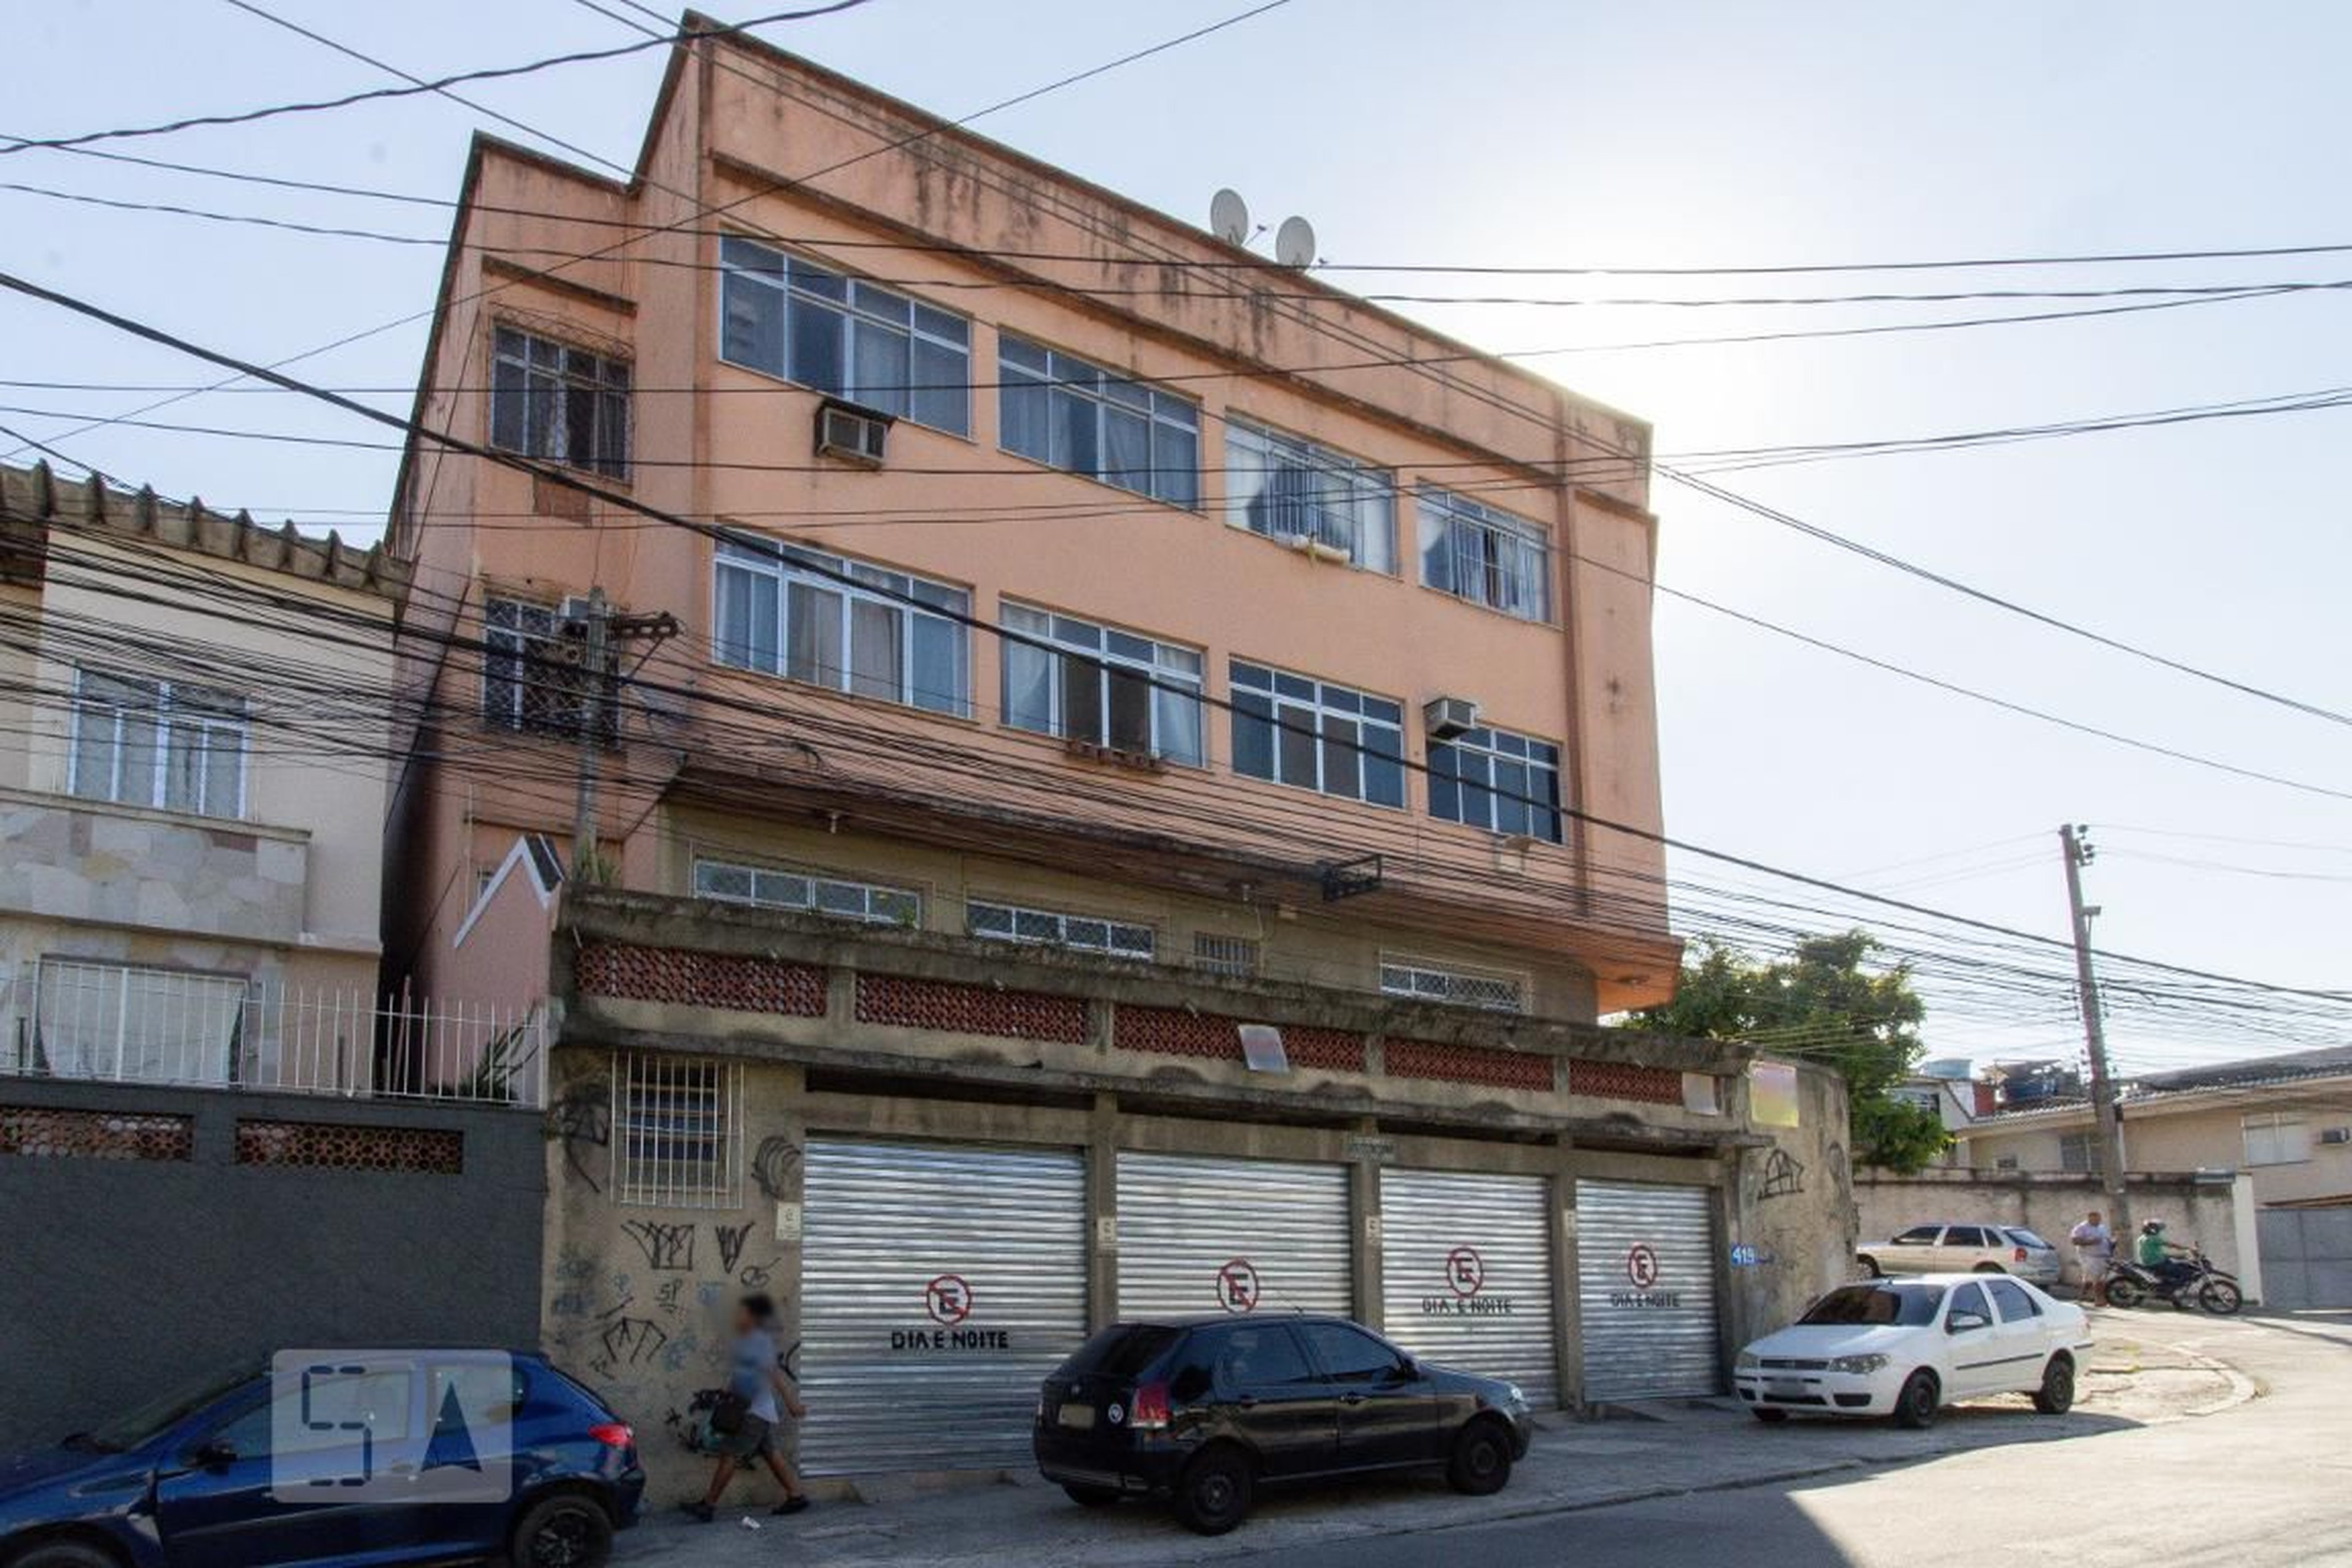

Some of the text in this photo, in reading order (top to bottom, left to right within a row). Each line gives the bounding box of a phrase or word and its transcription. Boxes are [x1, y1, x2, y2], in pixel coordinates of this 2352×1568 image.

[1422, 1297, 1511, 1314] DIA E NOITE
[891, 1331, 1009, 1349] DIA E NOITE
